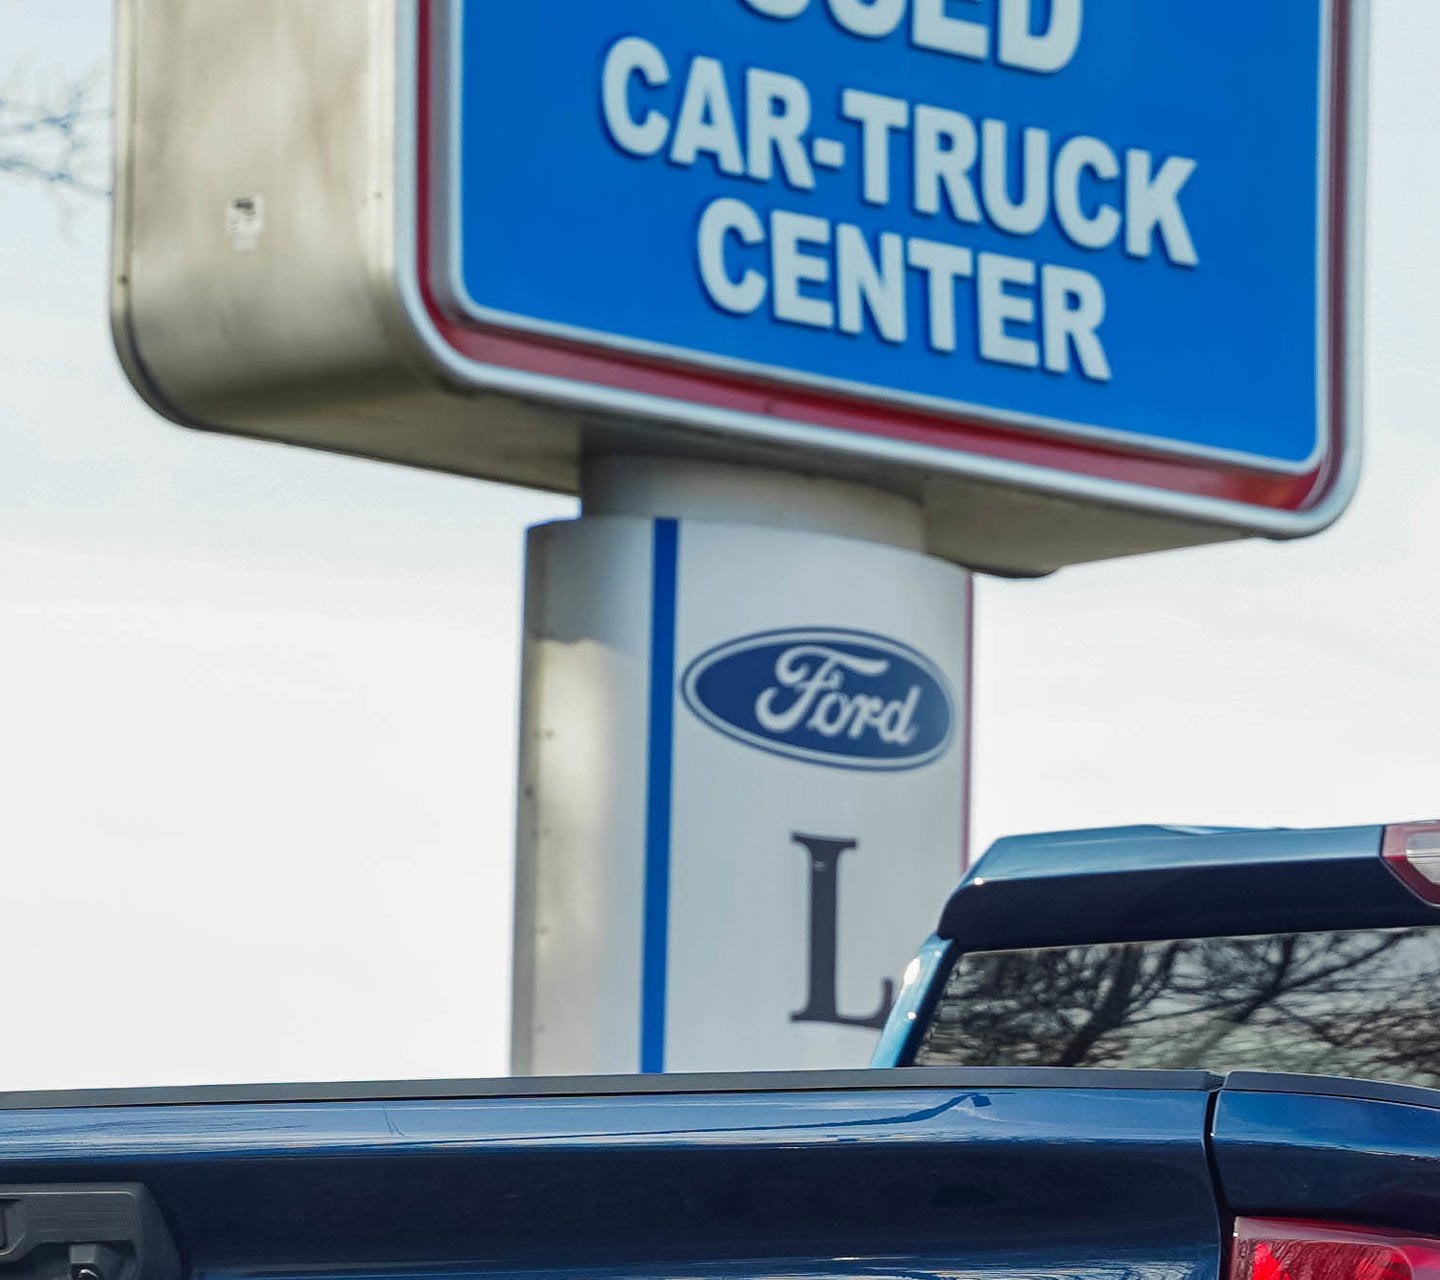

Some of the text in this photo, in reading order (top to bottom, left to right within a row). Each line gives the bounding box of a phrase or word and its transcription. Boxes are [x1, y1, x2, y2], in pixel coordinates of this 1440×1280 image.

[736, 0, 1082, 73] ED
[604, 36, 1199, 267] CAR-TRUCK
[697, 197, 1112, 381] CENTER
[754, 644, 922, 746] Ford
